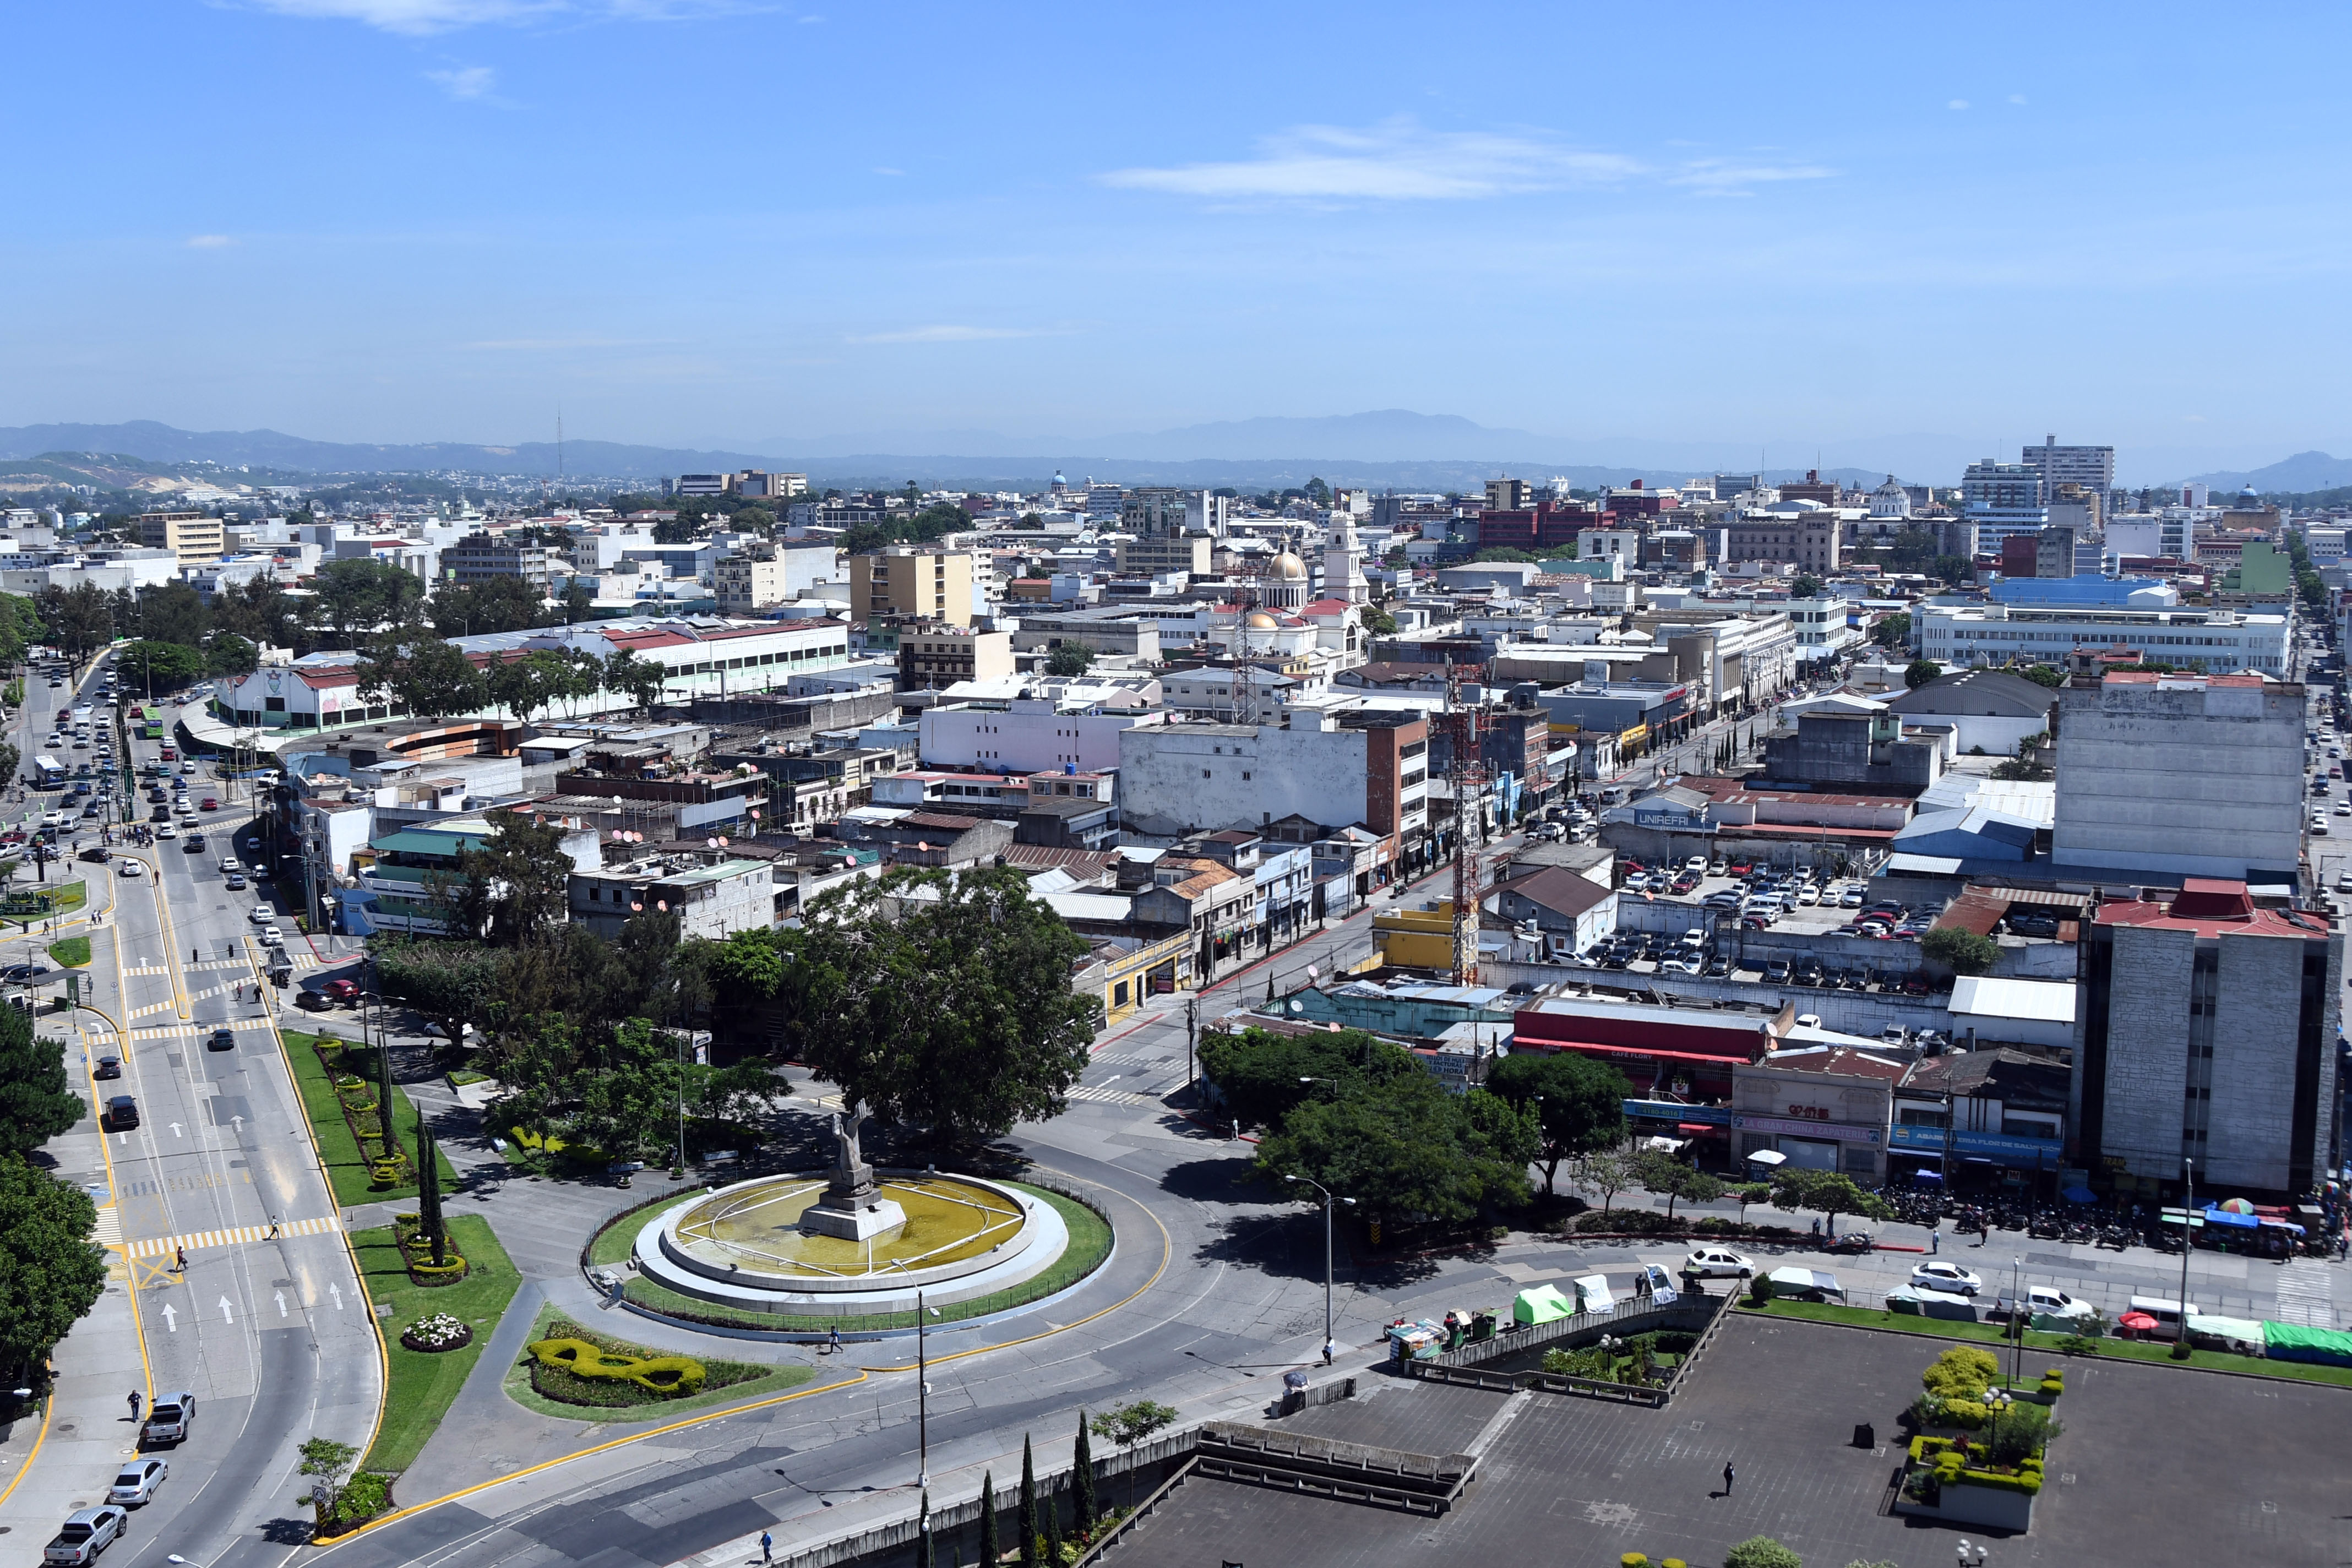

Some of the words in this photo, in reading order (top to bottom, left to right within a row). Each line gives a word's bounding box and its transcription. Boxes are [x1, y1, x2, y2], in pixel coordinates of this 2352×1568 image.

[1743, 1119, 1755, 1128] LA
[1757, 1120, 1782, 1131] GRAN
[1785, 1124, 1814, 1134] CHINA
